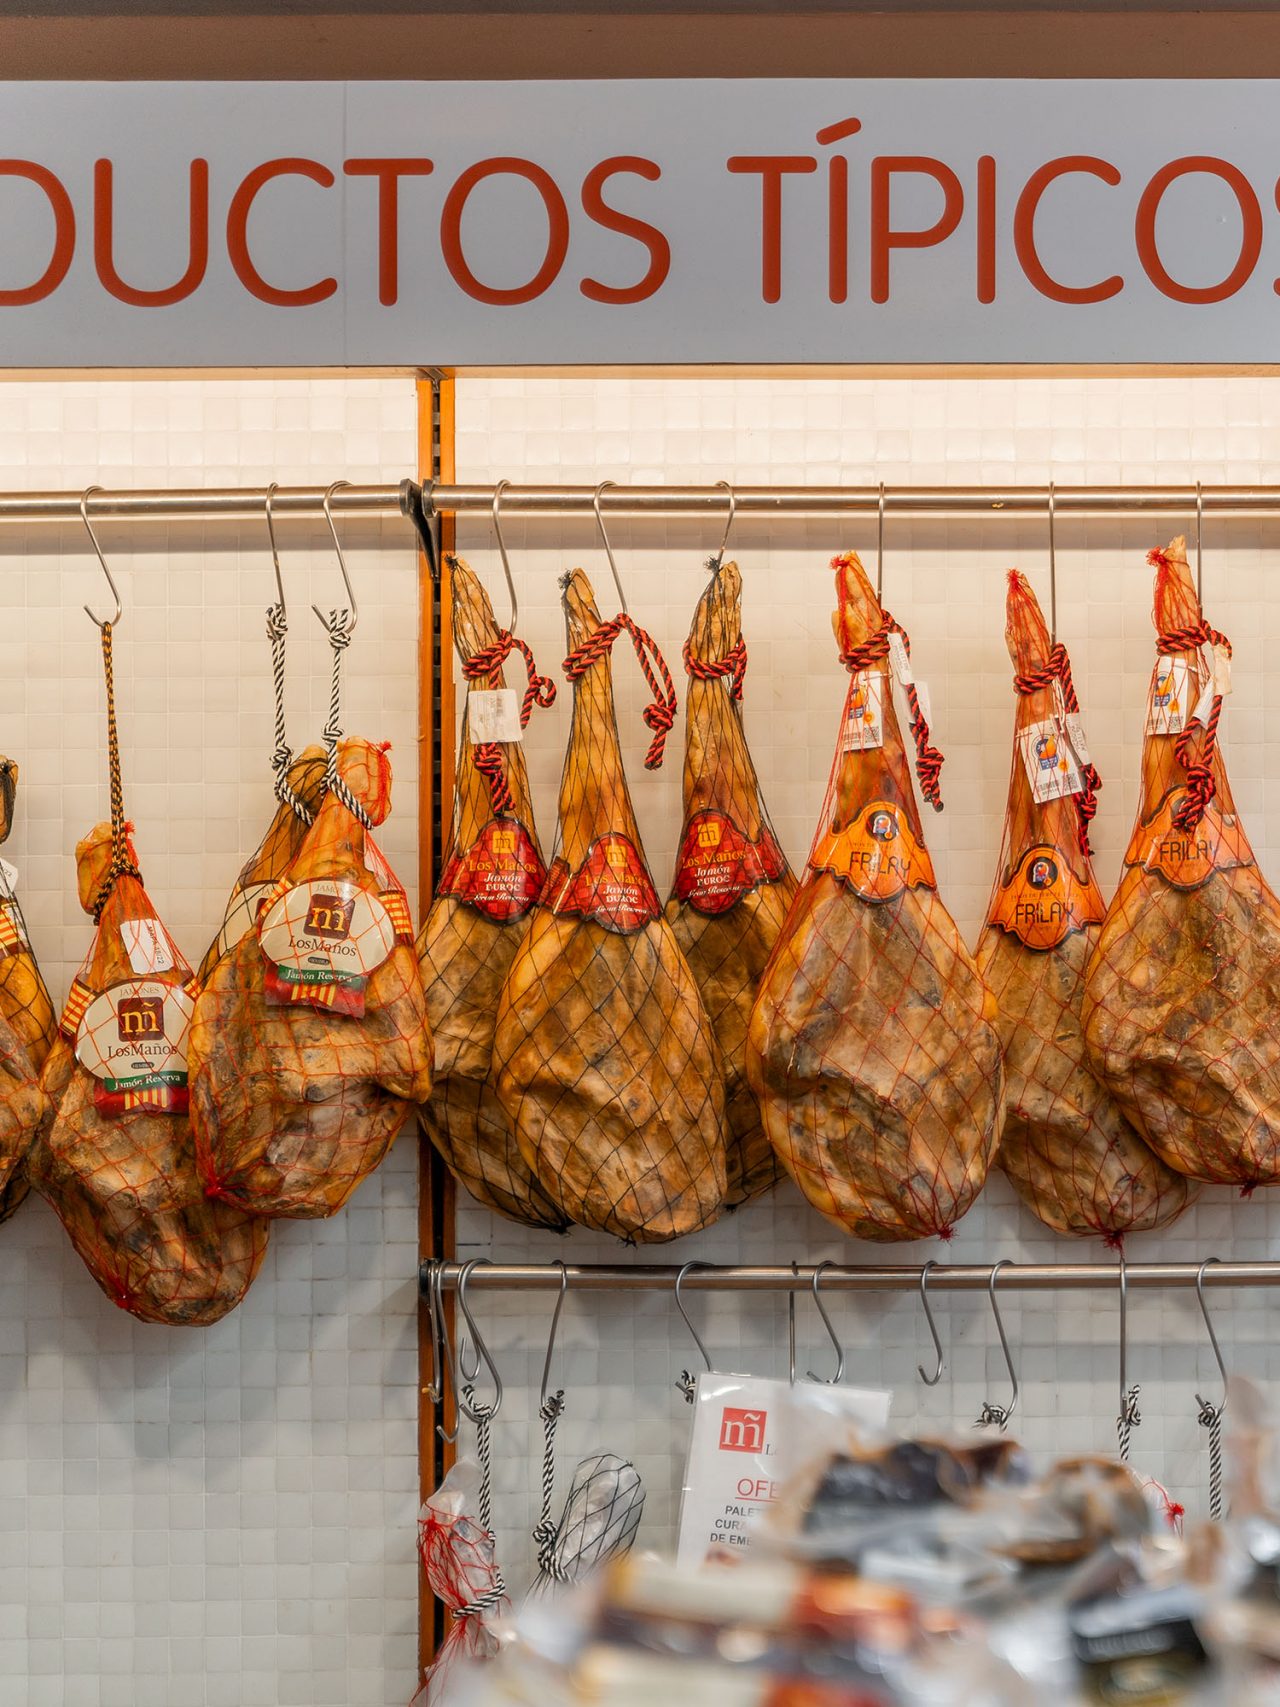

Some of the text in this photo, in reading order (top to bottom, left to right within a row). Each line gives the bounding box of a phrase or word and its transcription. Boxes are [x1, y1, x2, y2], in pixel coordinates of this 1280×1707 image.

[469, 859, 492, 872] Los
[485, 883, 521, 892] DUROC
[1015, 901, 1074, 925] FRILAY
[285, 969, 315, 980] Jamón
[710, 1533, 726, 1544] DE
